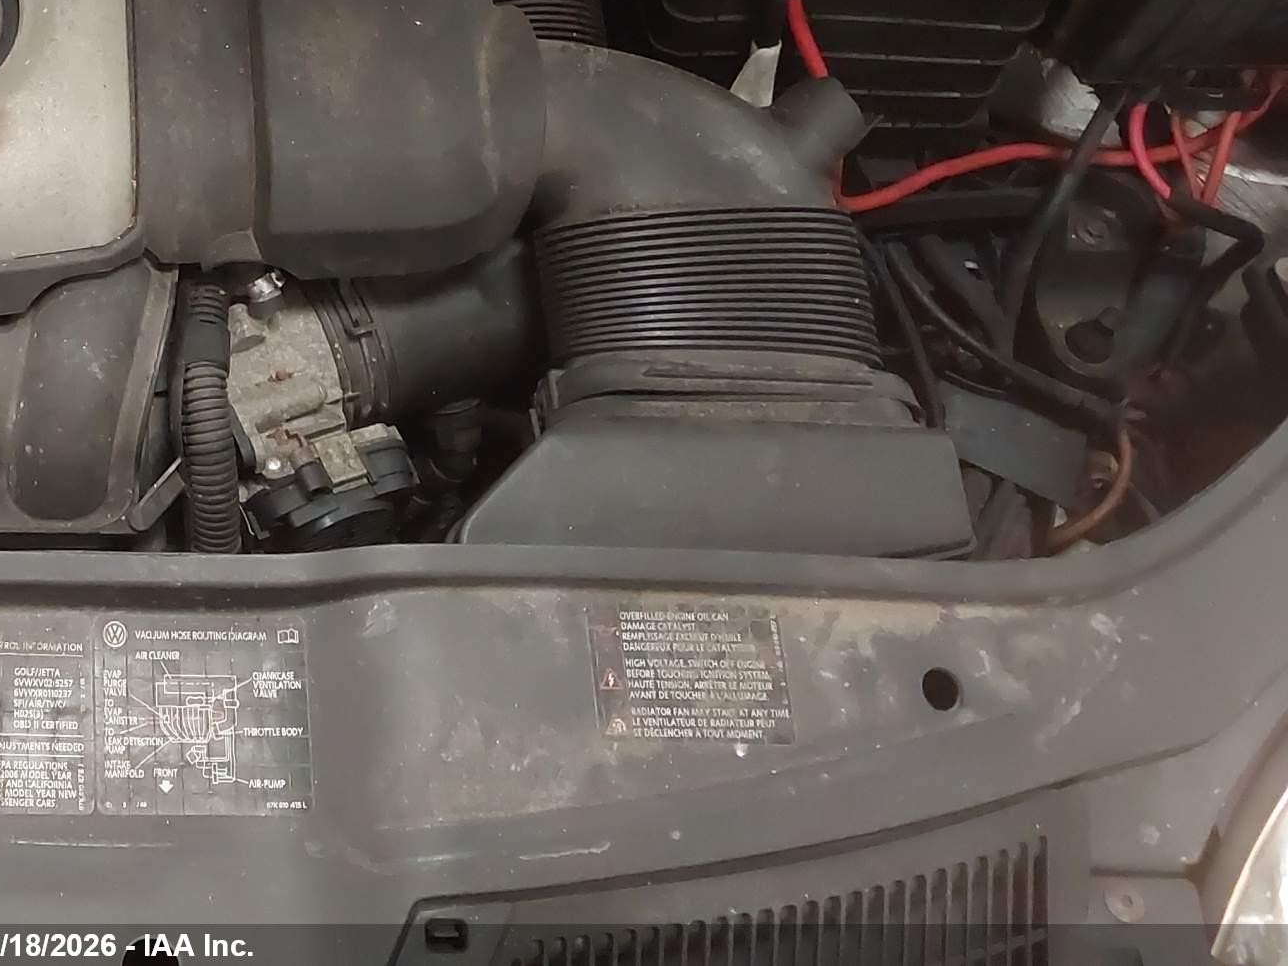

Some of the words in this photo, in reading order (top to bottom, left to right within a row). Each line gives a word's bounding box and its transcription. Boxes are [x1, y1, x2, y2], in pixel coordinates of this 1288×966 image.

[171, 631, 191, 641] HOSE
[192, 631, 227, 641] ROUTING
[229, 632, 267, 642] DIAGRAM
[252, 680, 302, 690] VENTILATION
[41, 721, 79, 731] CERTIFIED
[243, 727, 281, 737] THROTTLE
[281, 727, 304, 737] BODY
[51, 740, 85, 752] NEEDED
[123, 737, 164, 747] DETECTION
[20, 771, 50, 780] MODEL
[51, 771, 73, 781] YEAR
[104, 769, 145, 779] MANIFOLD
[153, 768, 179, 778] FRONT
[5, 780, 23, 790] AND
[248, 778, 286, 789] AIR-PUMP
[35, 790, 57, 799] YEAR
[58, 790, 78, 800] NEW
